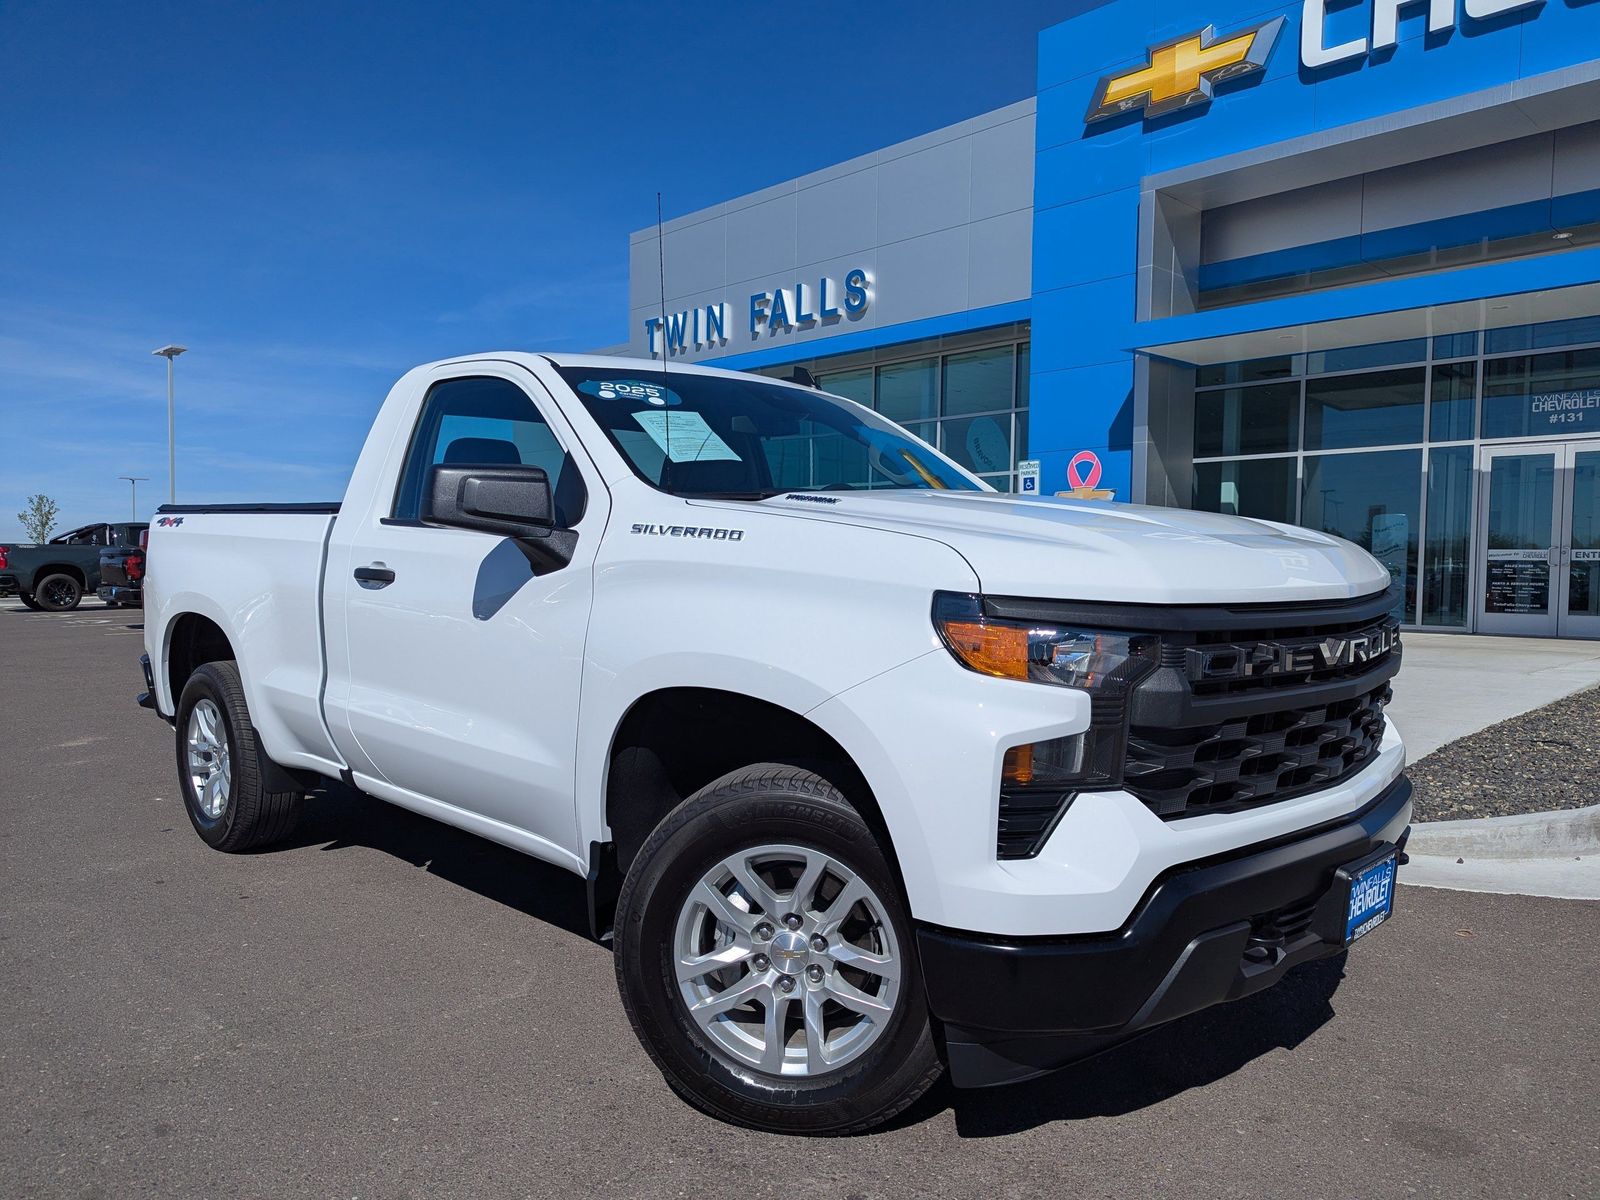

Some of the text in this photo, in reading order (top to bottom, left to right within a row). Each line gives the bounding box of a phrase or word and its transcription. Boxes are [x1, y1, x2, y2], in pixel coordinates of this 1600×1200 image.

[645, 268, 871, 356] TWIN FALLS
[600, 382, 660, 397] 2025
[1532, 396, 1600, 412] CHEVROLET
[1549, 412, 1583, 424] #131
[630, 523, 743, 541] SILVERADO
[1575, 551, 1600, 559] ENT
[1348, 878, 1390, 920] HEVROLET
